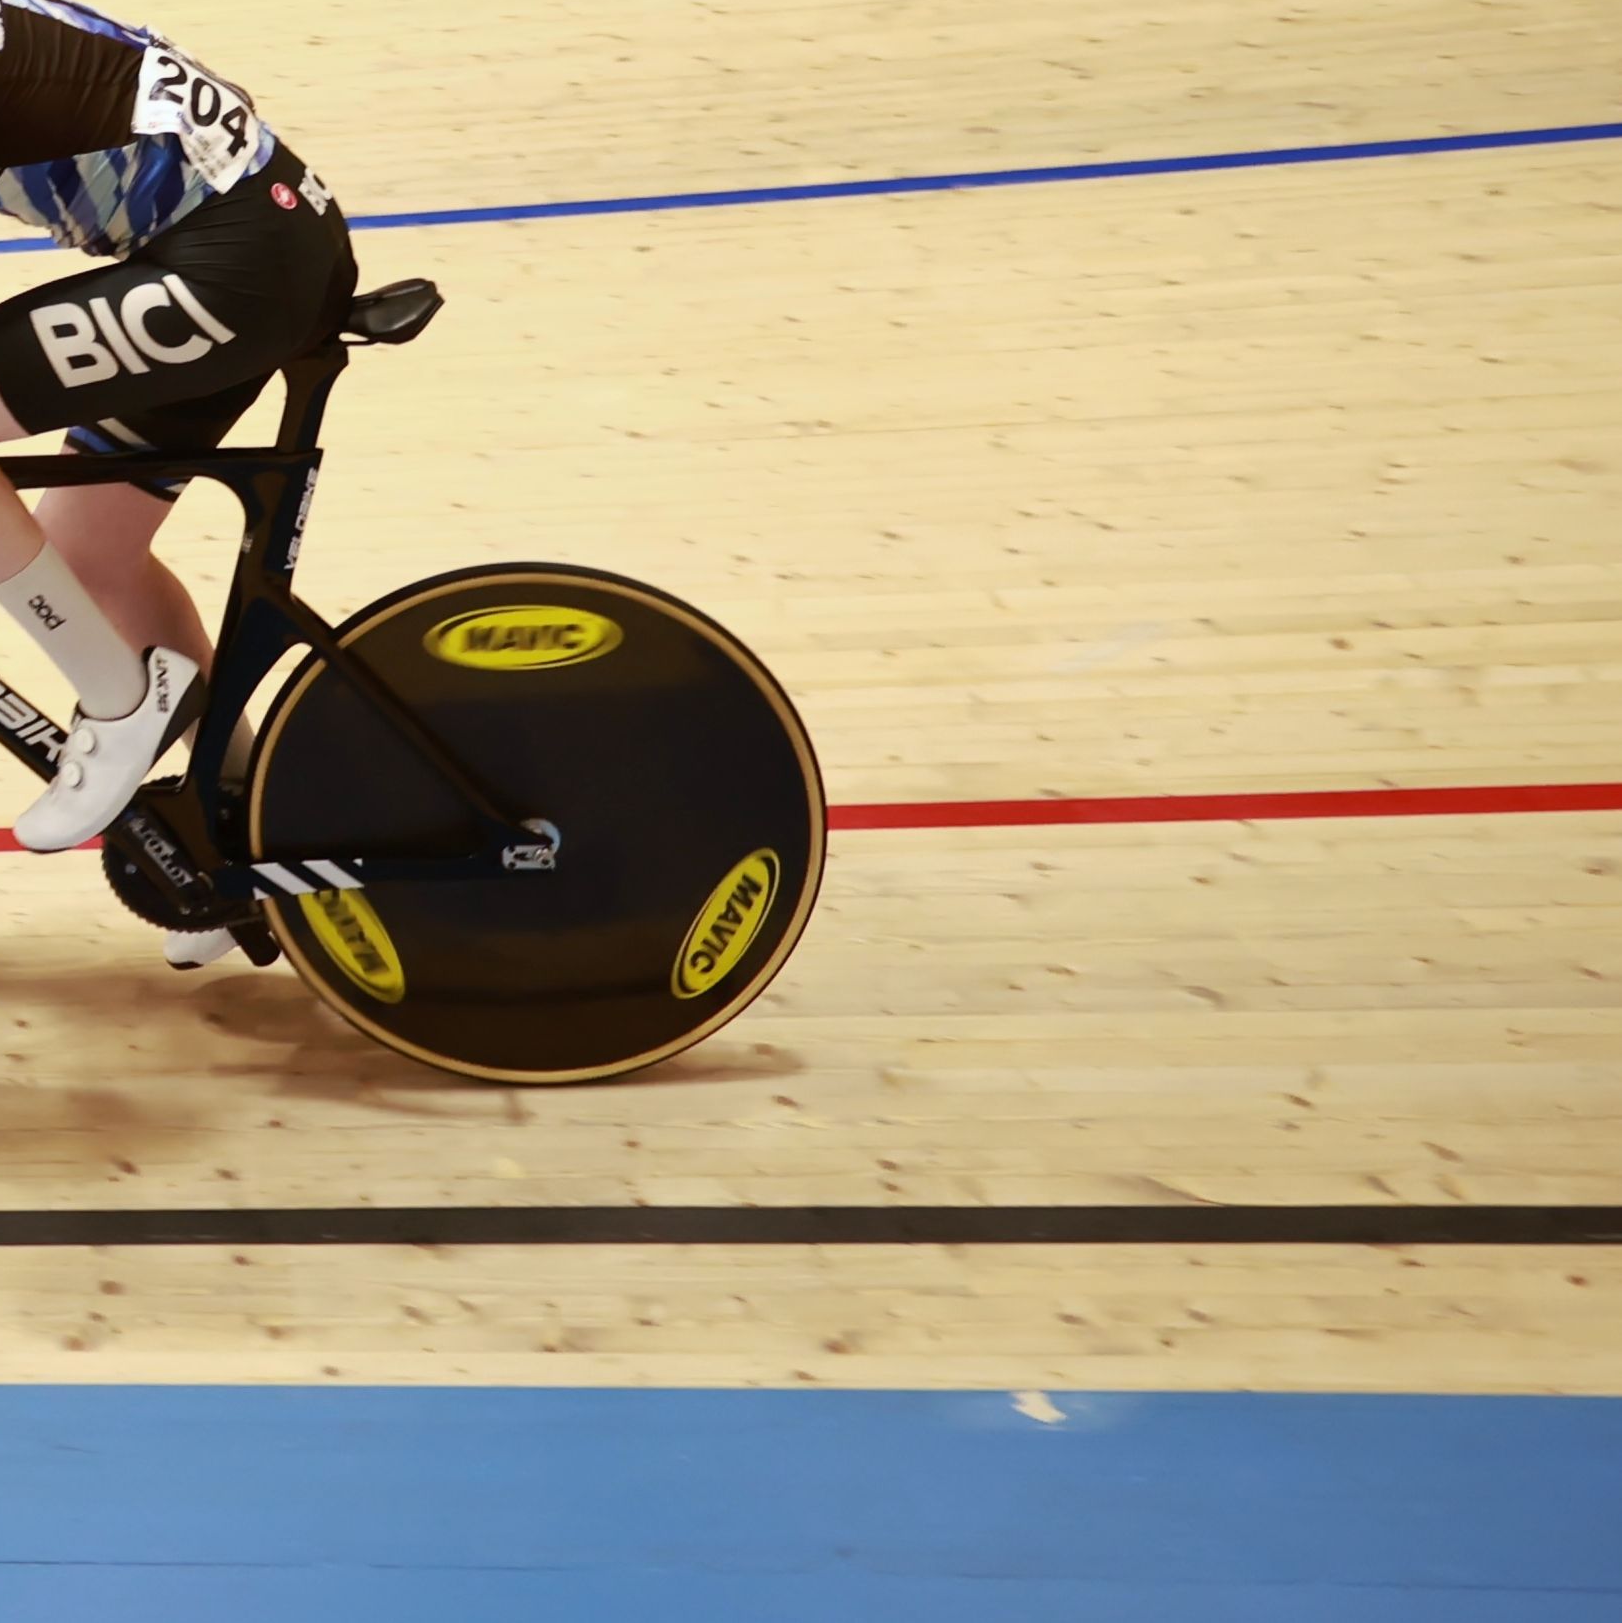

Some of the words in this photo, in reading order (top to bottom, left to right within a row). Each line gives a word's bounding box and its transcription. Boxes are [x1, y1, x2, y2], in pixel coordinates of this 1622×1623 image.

[149, 56, 248, 157] 204
[29, 273, 236, 388] BICI
[464, 624, 582, 652] MAVIC
[690, 873, 762, 974] MAVIC
